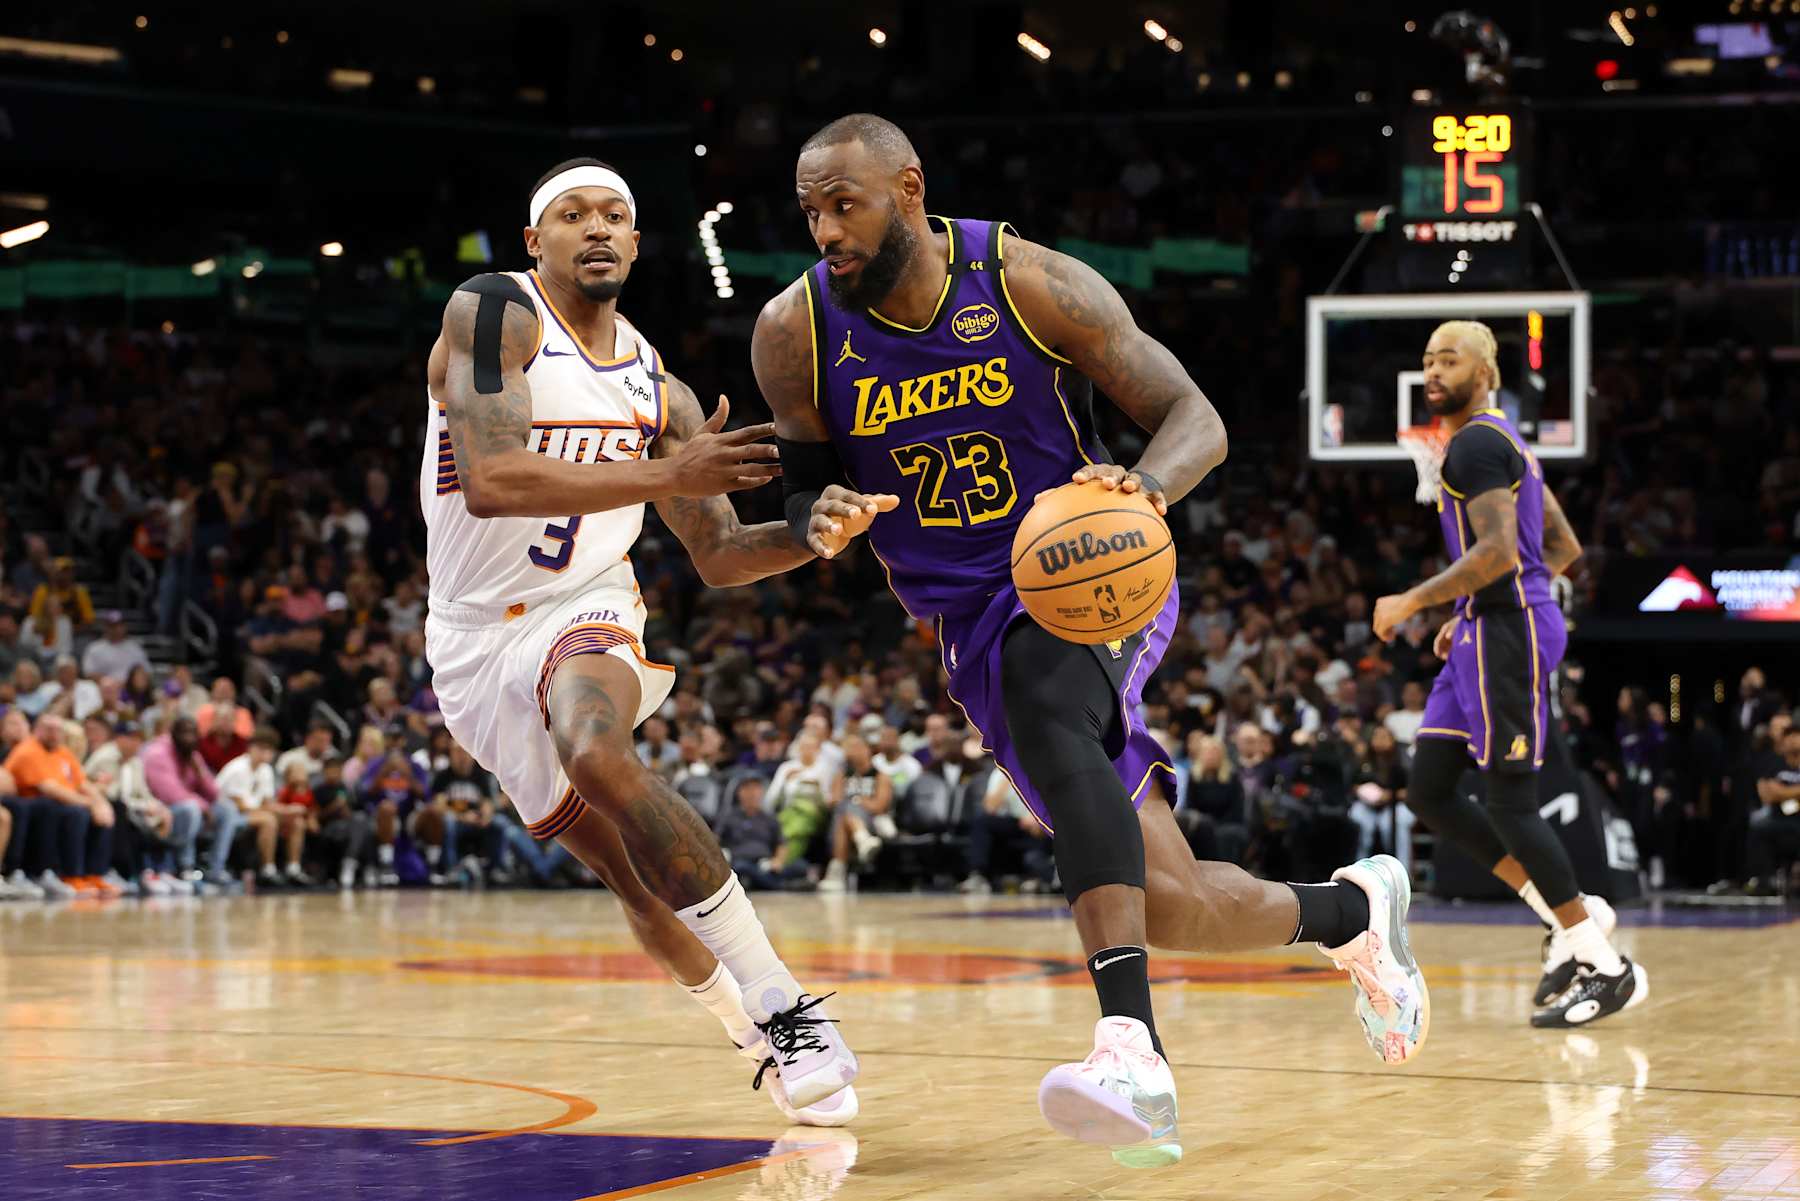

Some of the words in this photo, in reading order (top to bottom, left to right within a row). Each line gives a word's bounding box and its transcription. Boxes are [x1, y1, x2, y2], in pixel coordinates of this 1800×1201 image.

[1433, 115, 1511, 152] 9:20
[1444, 152, 1504, 213] 15
[969, 261, 984, 271] 44
[955, 313, 997, 331] bibigo
[623, 376, 652, 403] PayPal
[850, 357, 1014, 436] LAKERS
[889, 431, 1018, 528] 23
[528, 514, 583, 575] 3
[1037, 529, 1148, 576] Wilson
